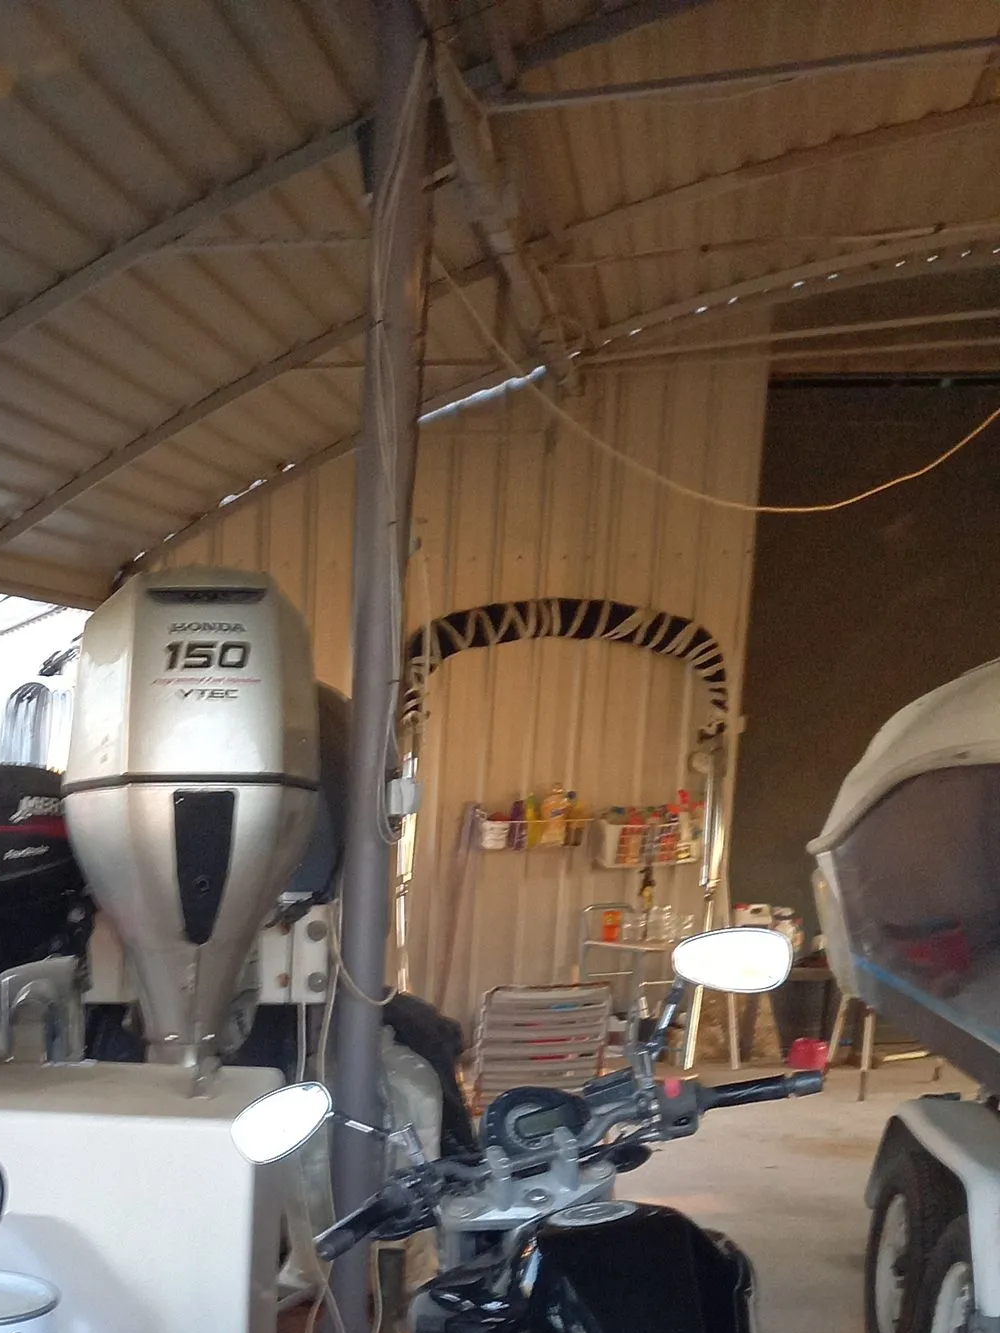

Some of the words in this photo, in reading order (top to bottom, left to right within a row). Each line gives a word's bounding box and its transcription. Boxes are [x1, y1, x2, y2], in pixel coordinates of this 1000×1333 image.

[168, 621, 248, 634] HONDA
[164, 640, 251, 671] 150
[176, 688, 239, 700] VTEC
